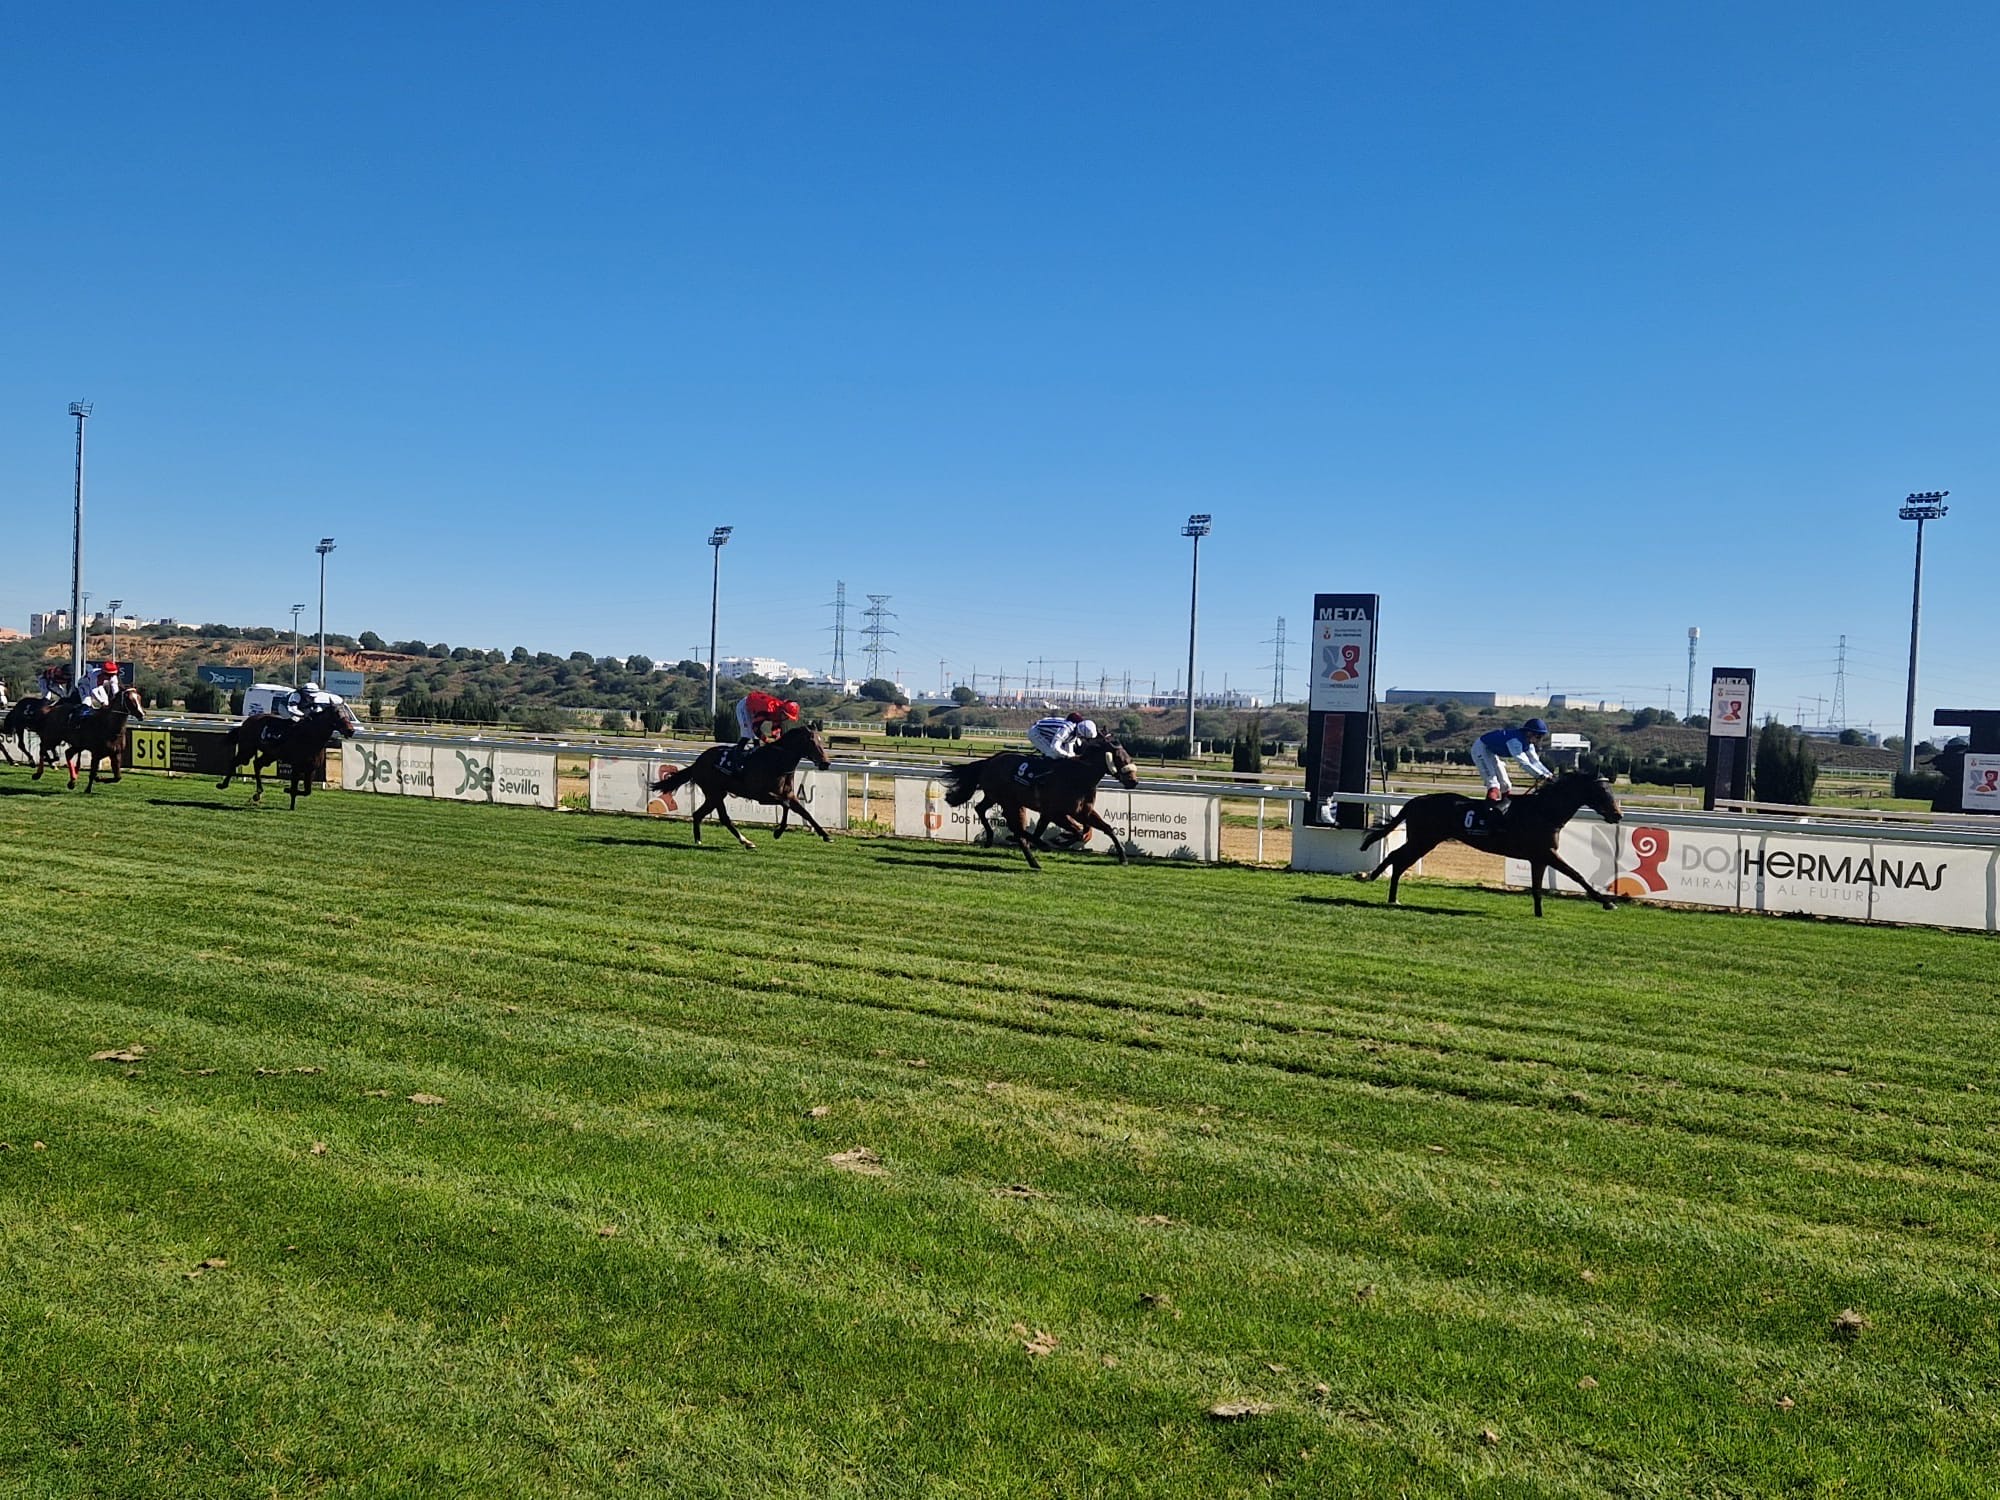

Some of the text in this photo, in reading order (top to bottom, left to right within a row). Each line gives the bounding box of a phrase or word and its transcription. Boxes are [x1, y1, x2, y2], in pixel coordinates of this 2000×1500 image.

[1320, 607, 1367, 621] META
[137, 738, 166, 760] SIS
[1017, 762, 1029, 777] 9
[396, 769, 435, 788] Sevilla
[499, 777, 539, 796] Sevilla
[951, 812, 971, 825] Dos
[1103, 808, 1187, 824] Ayuntamiento de
[1464, 809, 1475, 828] 6
[1128, 826, 1187, 841] Hermanas
[1681, 876, 1881, 903] MIRANDO AL FUTURO
